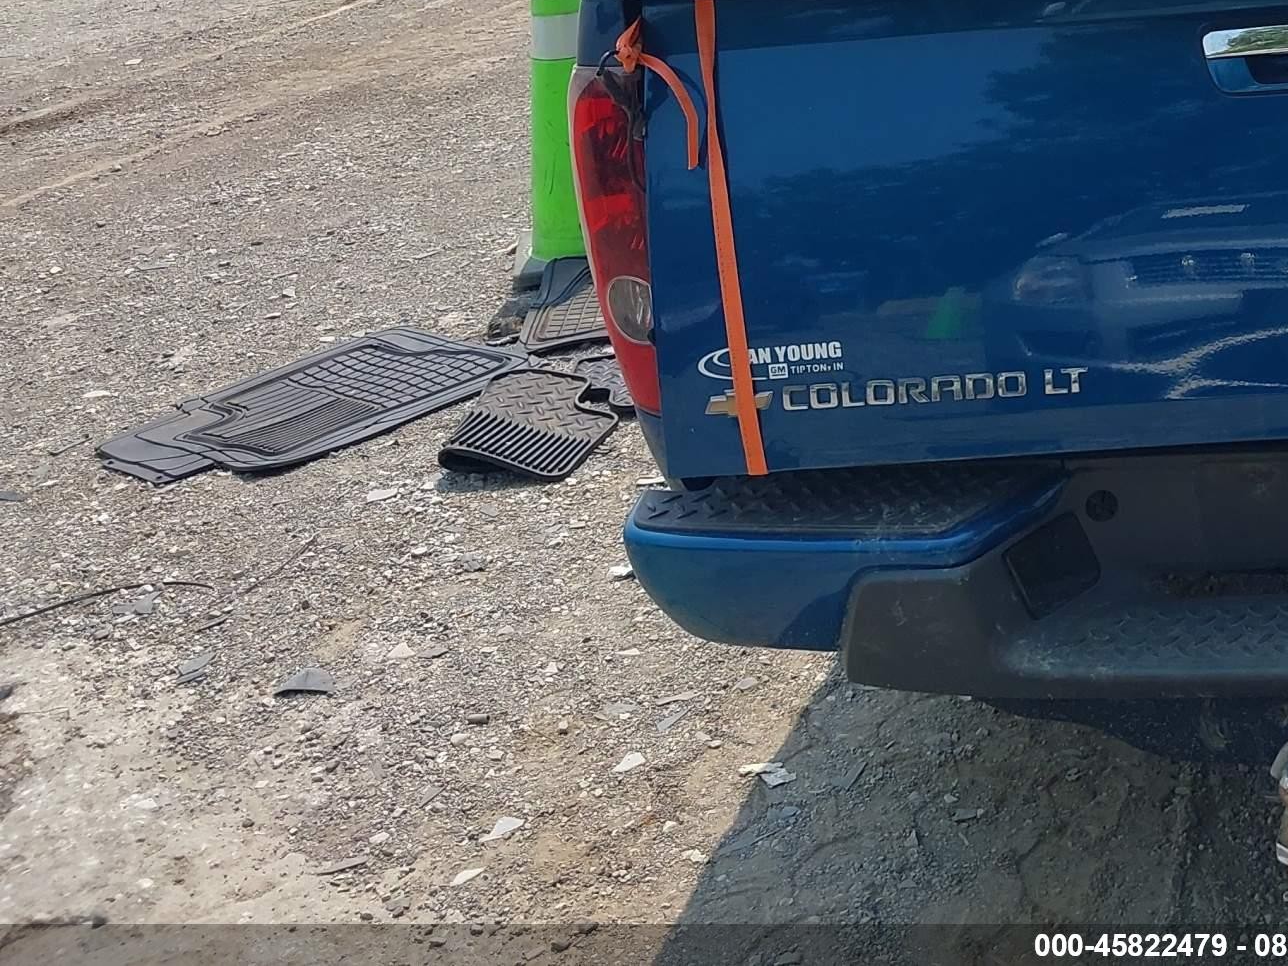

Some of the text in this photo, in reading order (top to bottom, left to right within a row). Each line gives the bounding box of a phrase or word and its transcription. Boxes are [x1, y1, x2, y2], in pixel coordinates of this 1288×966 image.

[748, 341, 842, 365] AN YOUNG
[770, 366, 787, 375] GM
[833, 362, 844, 371] IN
[782, 367, 1088, 411] COLORADO LT
